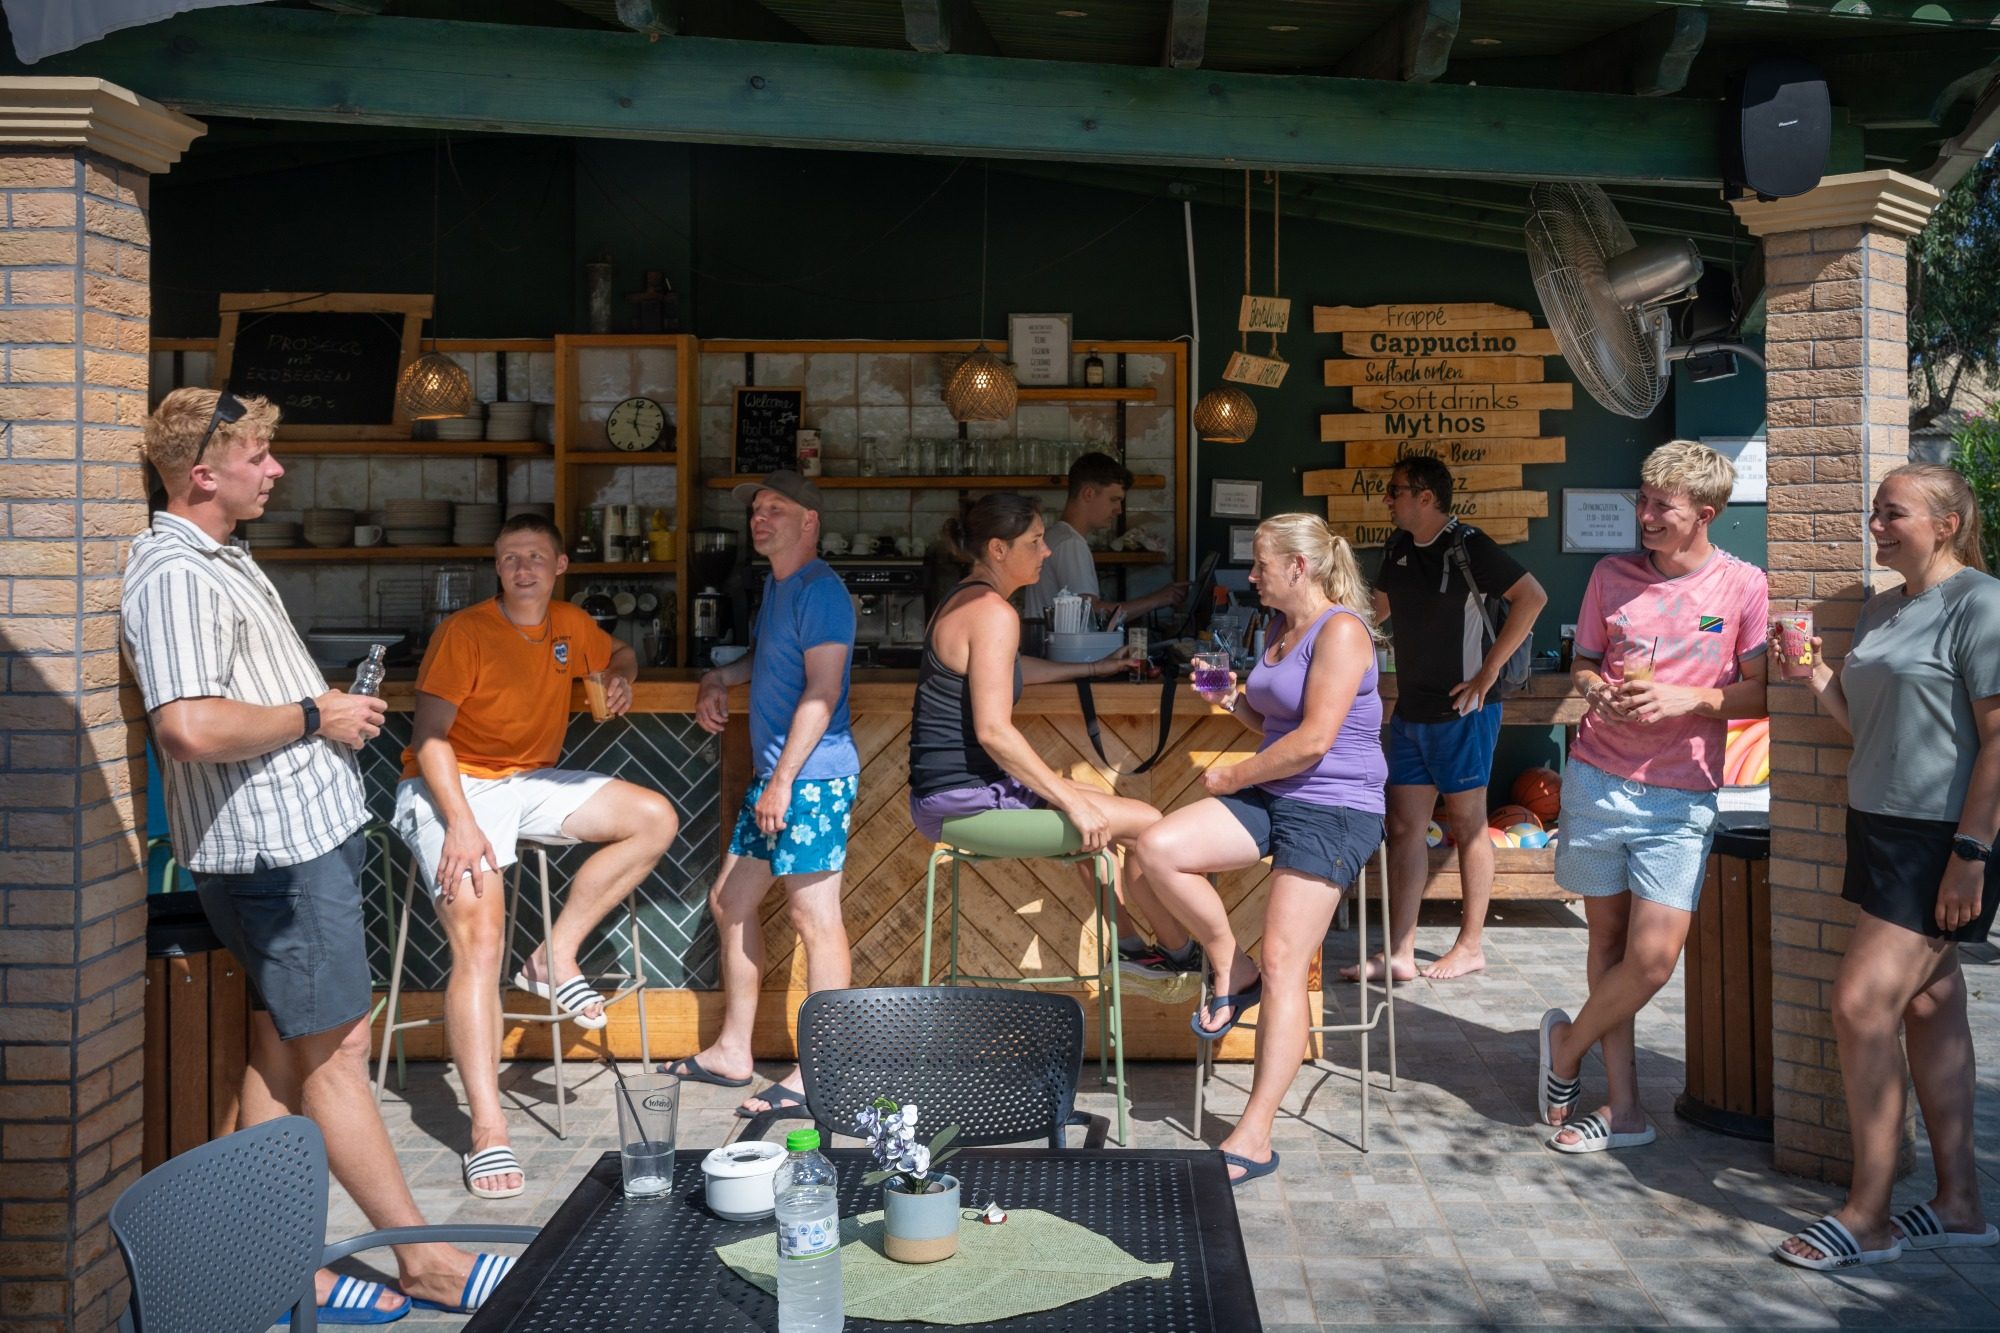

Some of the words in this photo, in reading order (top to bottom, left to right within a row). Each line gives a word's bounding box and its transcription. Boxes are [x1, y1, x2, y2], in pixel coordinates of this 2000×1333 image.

[1386, 305, 1447, 330] Frappé
[1370, 331, 1517, 356] Cappucino
[1385, 413, 1486, 438] Mythos
[1451, 442, 1486, 463] Beer
[1351, 469, 1385, 502] Ape
[1449, 499, 1478, 515] nic
